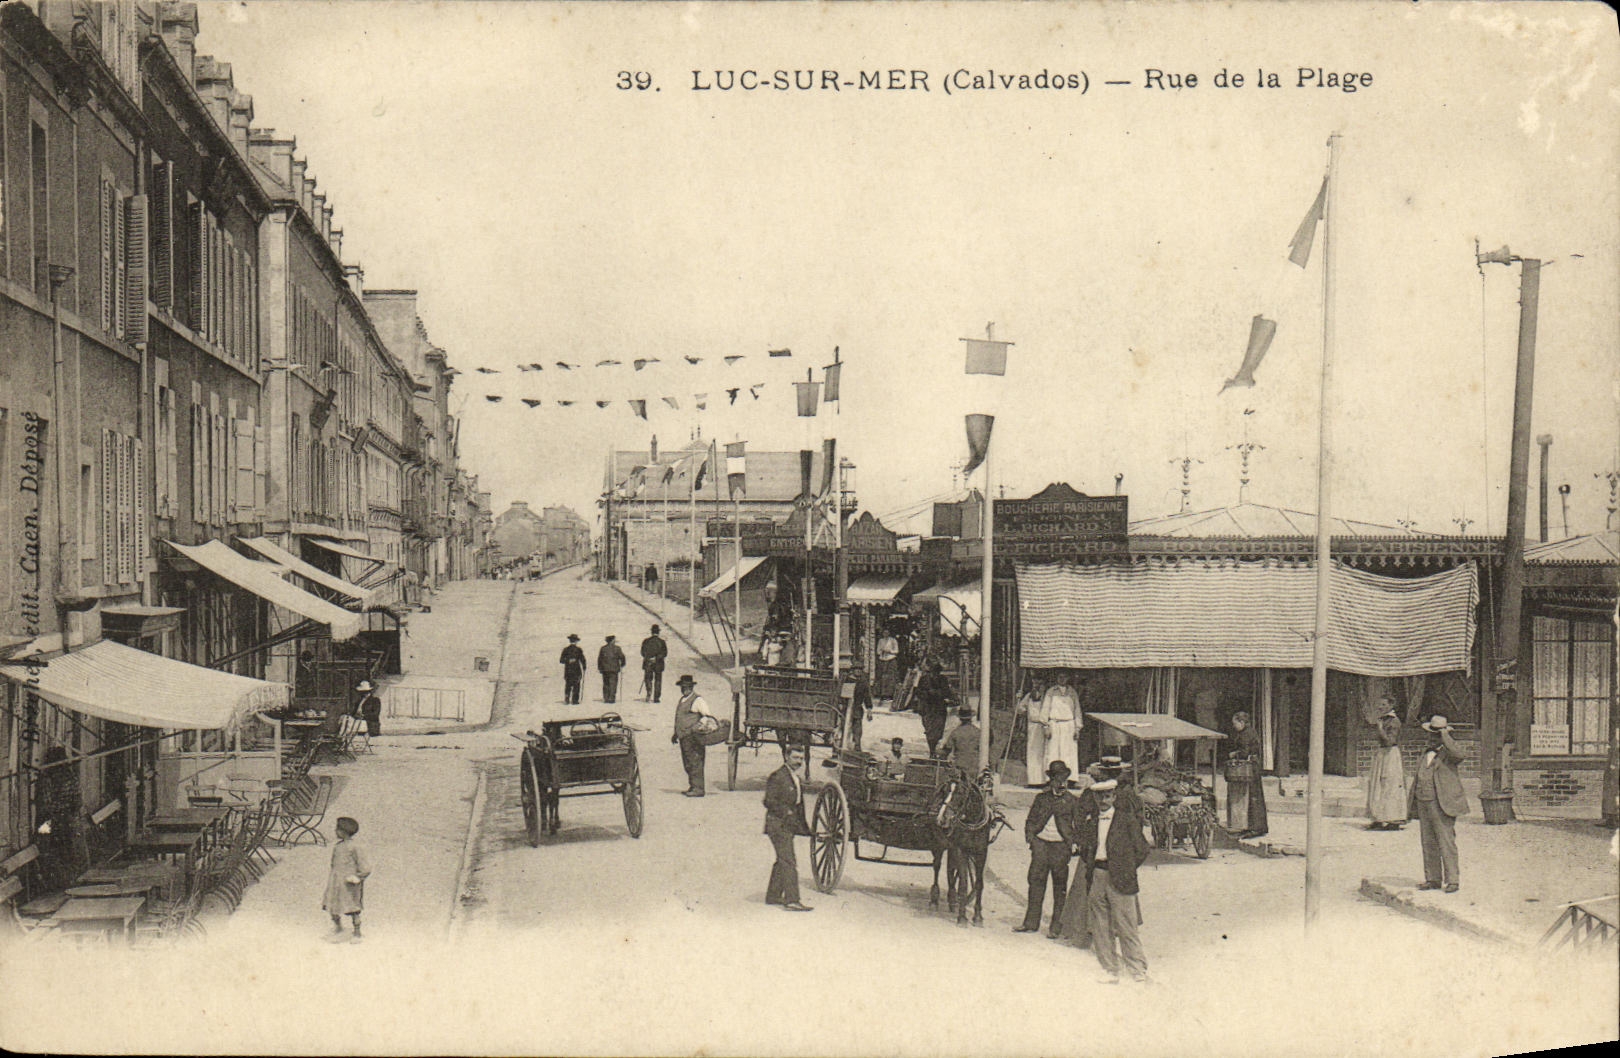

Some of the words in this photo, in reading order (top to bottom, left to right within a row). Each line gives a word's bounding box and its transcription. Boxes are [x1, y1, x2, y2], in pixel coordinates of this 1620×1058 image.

[997, 502, 1060, 515] BOUCHERIE
[1063, 500, 1124, 513] PARISIENNE
[1021, 522, 1099, 533] PICHARD
[1015, 540, 1118, 554] PICHARD
[1164, 540, 1314, 552] BOUCHERIE
[1357, 541, 1498, 553] PARISIENNE
